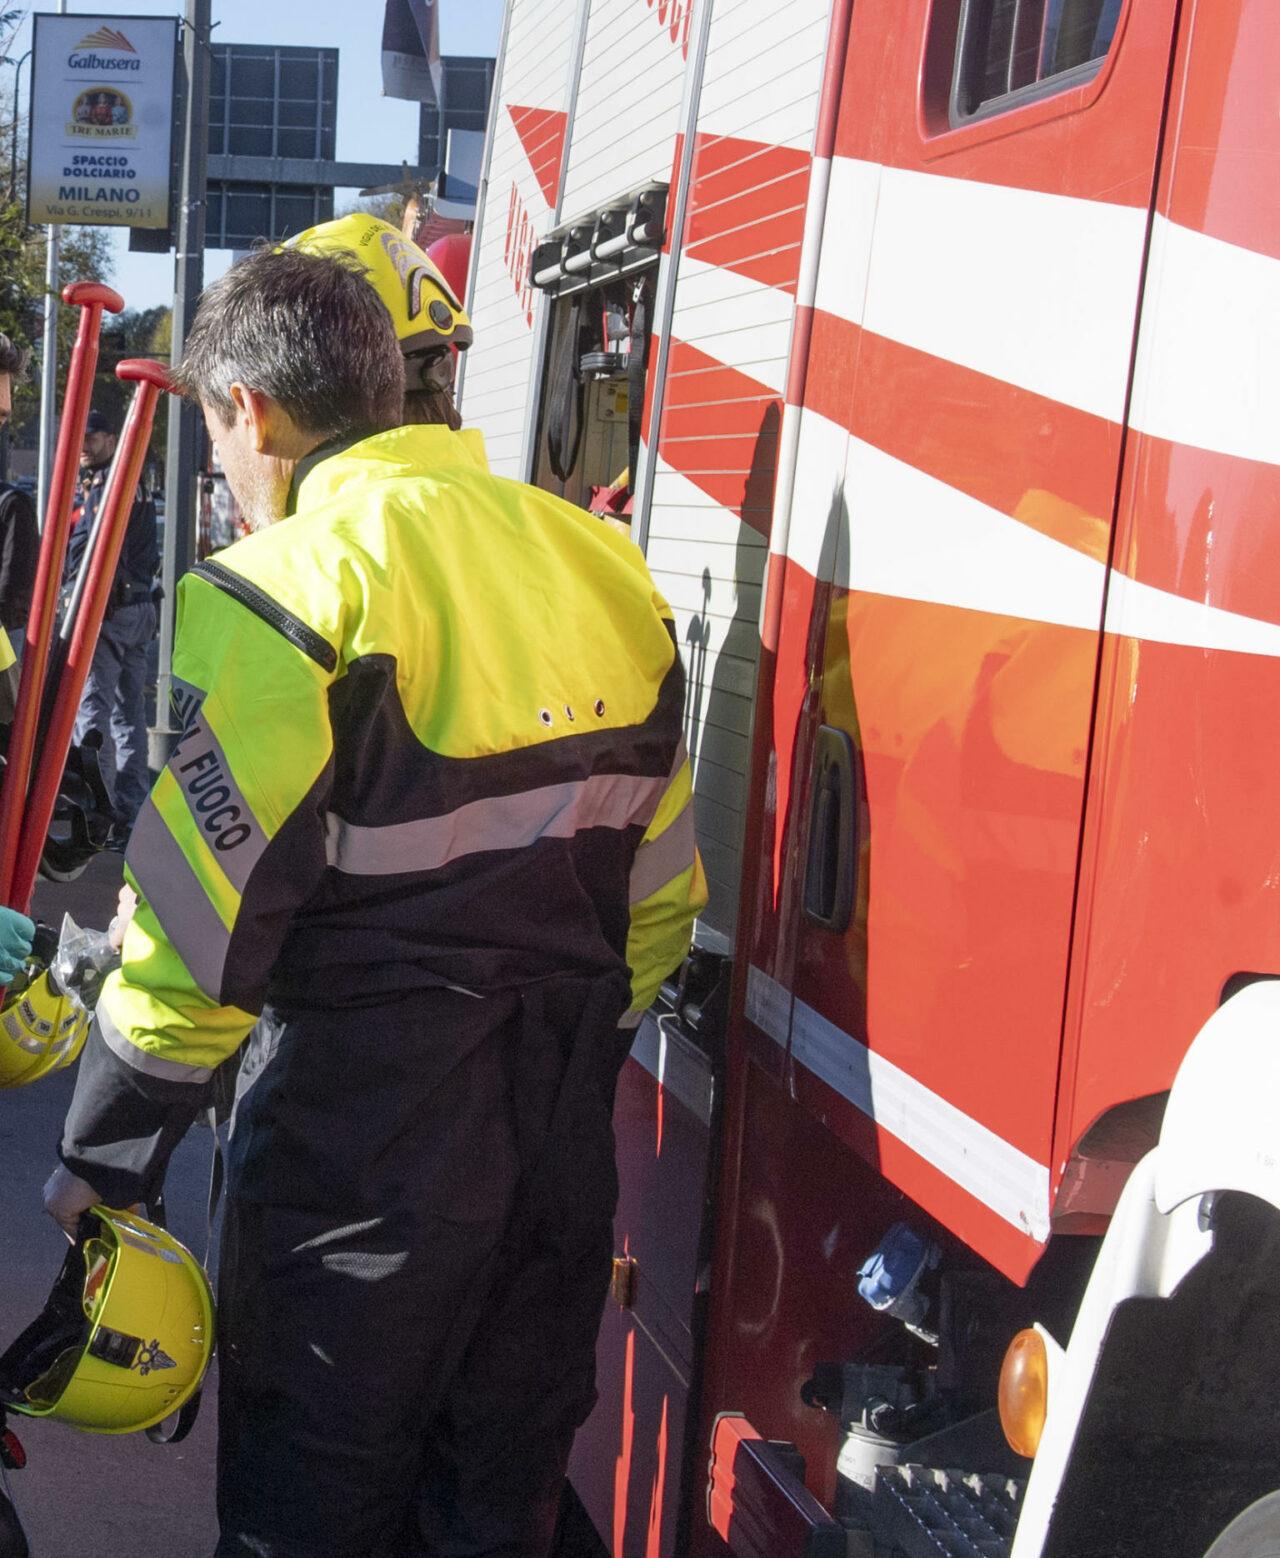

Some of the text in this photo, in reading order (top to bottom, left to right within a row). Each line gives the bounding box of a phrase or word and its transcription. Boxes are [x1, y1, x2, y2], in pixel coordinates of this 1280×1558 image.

[68, 53, 141, 71] Galbusera
[72, 125, 133, 137] TRE MARIE
[72, 155, 128, 167] SPACCIO
[63, 167, 136, 179] DOLCIARIO
[59, 186, 140, 203] MILANO
[47, 205, 64, 216] Via
[67, 206, 80, 217] G.
[126, 208, 152, 218] 9/11
[179, 750, 251, 851] FUOCO
